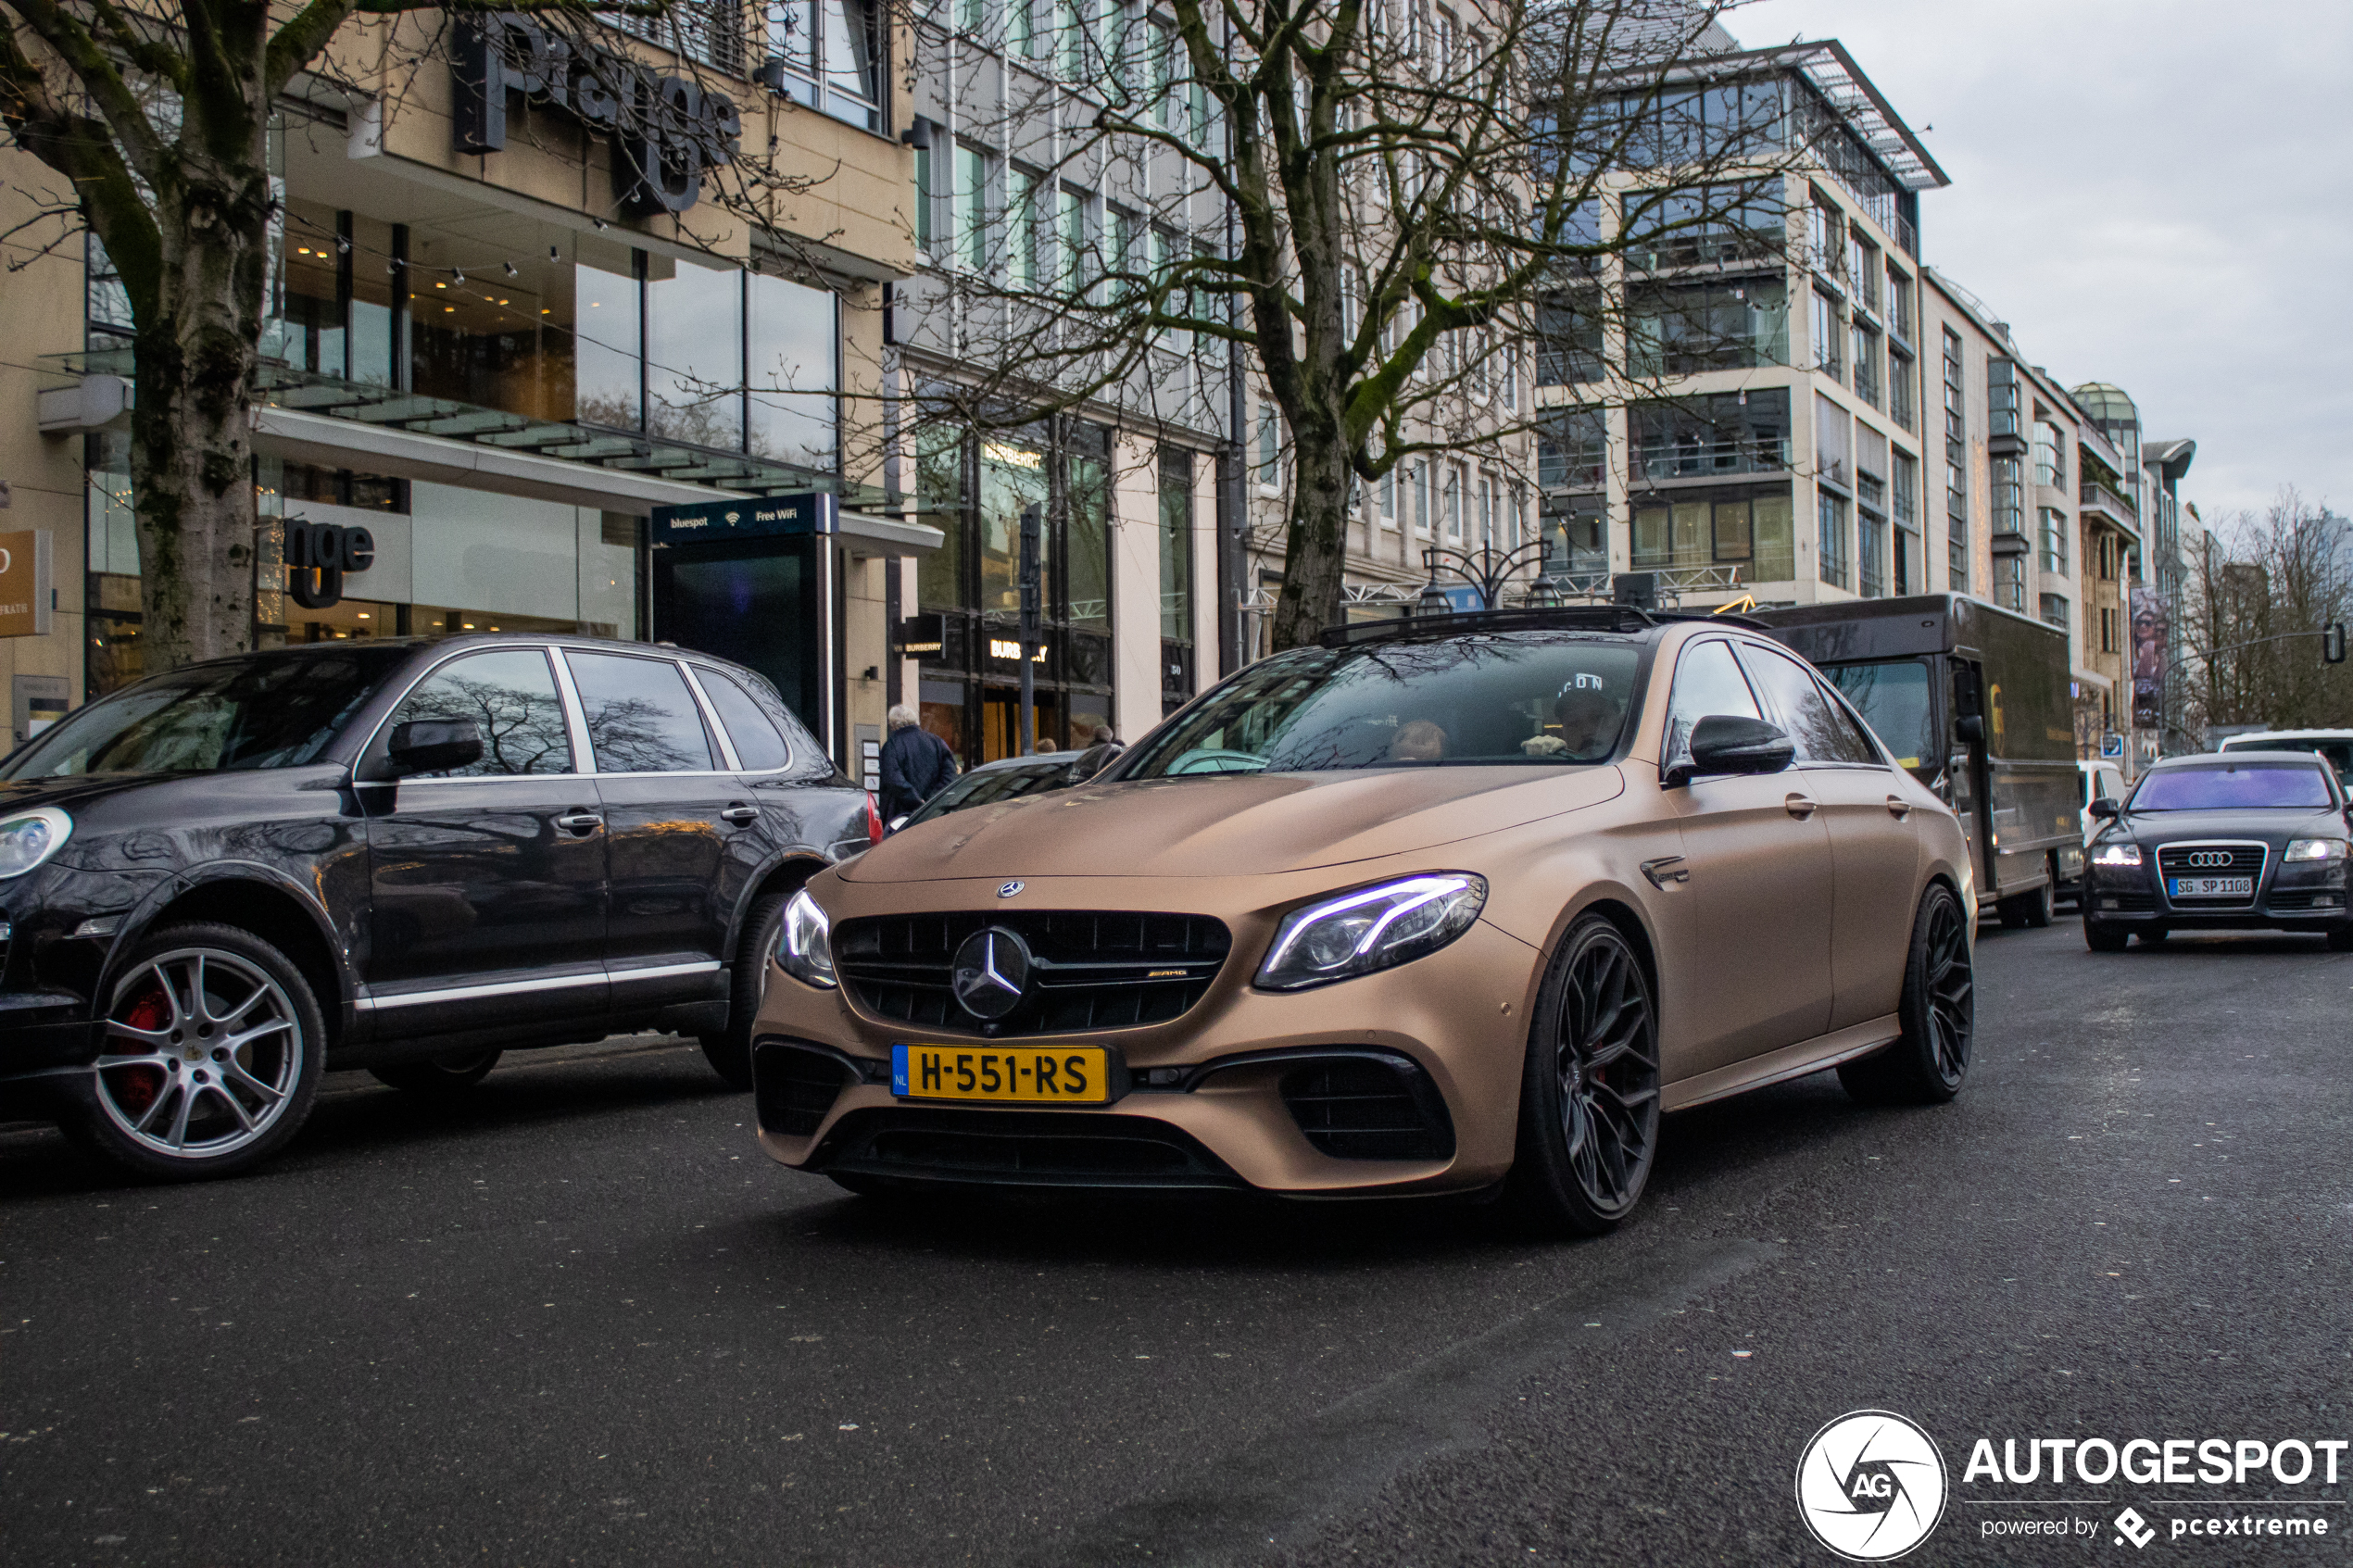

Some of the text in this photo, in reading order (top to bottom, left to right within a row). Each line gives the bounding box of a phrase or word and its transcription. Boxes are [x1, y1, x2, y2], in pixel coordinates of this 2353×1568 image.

[985, 443, 1041, 470] BURBERRY
[756, 508, 797, 521] Free WiFi
[671, 517, 708, 529] bluespot
[283, 519, 375, 609] nge
[905, 642, 941, 652] BURBERRY
[990, 639, 1048, 662] BURBY
[1171, 664, 1181, 675] 50
[2178, 879, 2250, 893] SG SP 1108
[895, 1074, 906, 1086] NL
[922, 1053, 1088, 1094] H-551-RS
